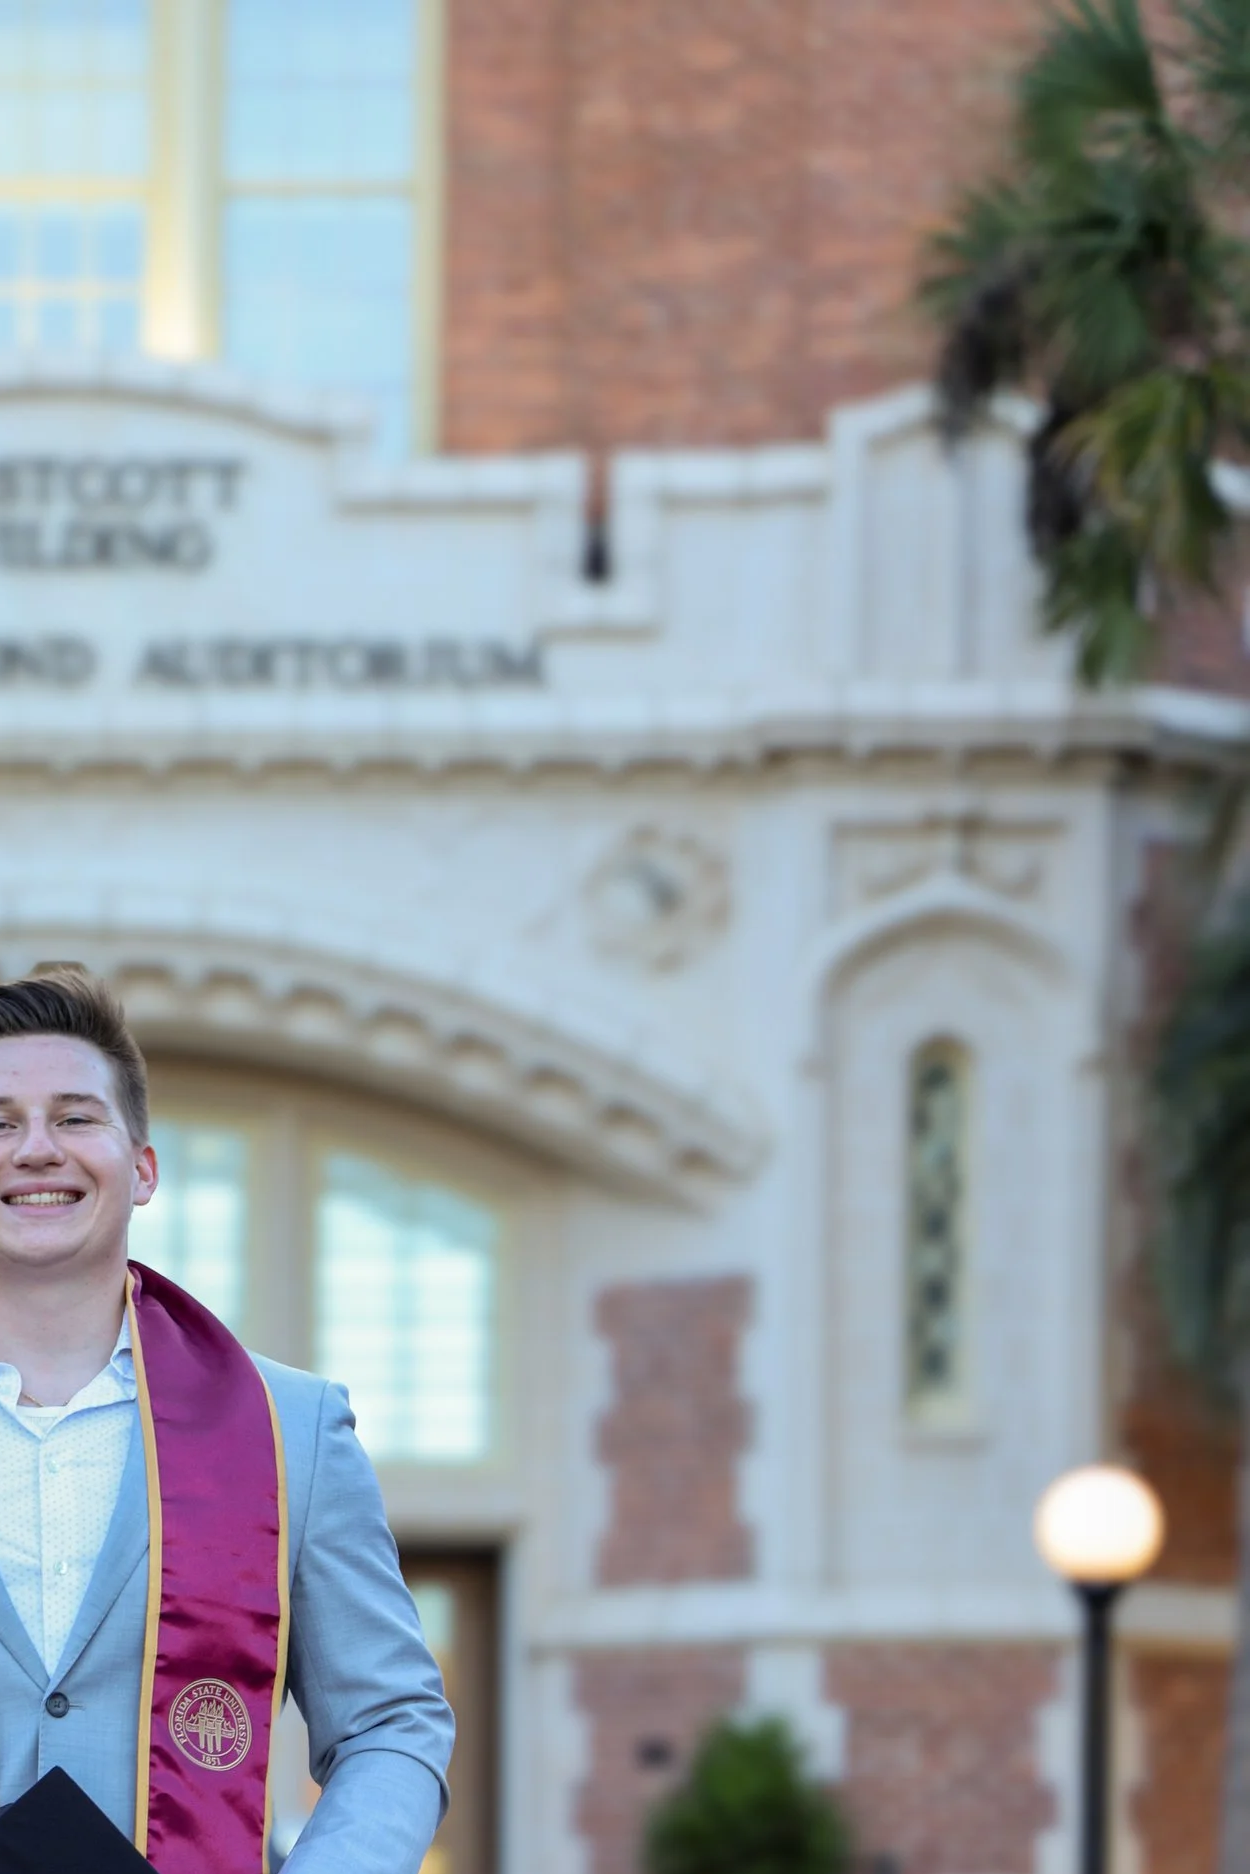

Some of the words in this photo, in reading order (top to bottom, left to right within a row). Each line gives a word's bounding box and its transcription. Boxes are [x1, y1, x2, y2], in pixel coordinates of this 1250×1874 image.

[131, 634, 546, 690] AUDITORIUM
[174, 1696, 192, 1745] FLORIDA
[192, 1685, 223, 1699] STATE
[223, 1692, 247, 1756] UNIVERSITY
[201, 1754, 222, 1766] 1851
